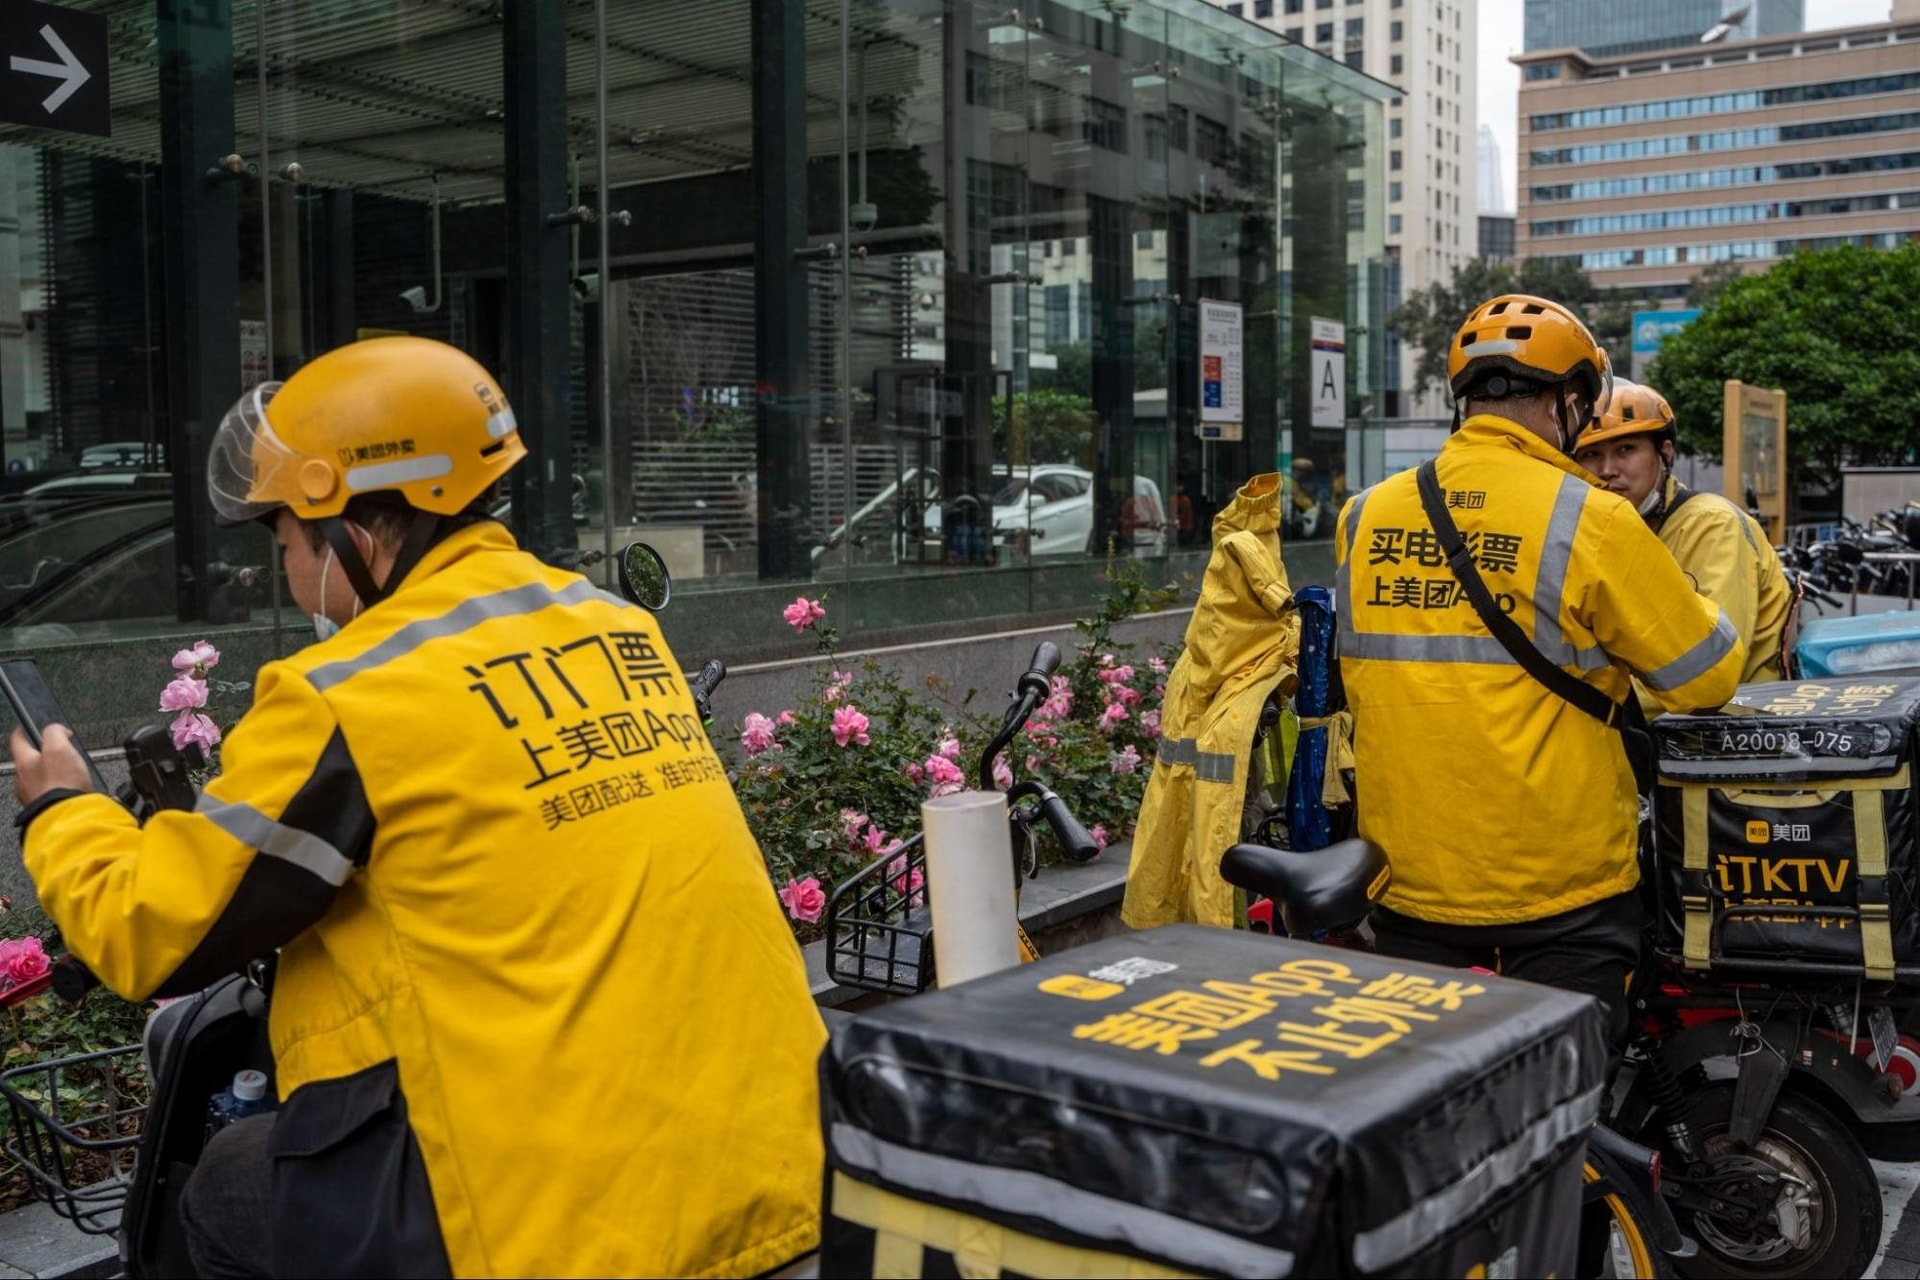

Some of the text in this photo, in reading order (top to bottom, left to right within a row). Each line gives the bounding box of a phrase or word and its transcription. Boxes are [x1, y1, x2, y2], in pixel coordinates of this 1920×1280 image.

[1321, 359, 1337, 400] A
[1448, 491, 1486, 509] 美团
[1367, 576, 1516, 615] 上美团Ap
[463, 632, 680, 729] 订门票
[521, 709, 705, 790] 上美团App
[539, 770, 655, 831] 美团配送
[1772, 824, 1810, 841] 美团
[1715, 854, 1850, 894] 订KTV
[1071, 959, 1362, 1055] 美团App
[1199, 972, 1486, 1080] 不止外卖
